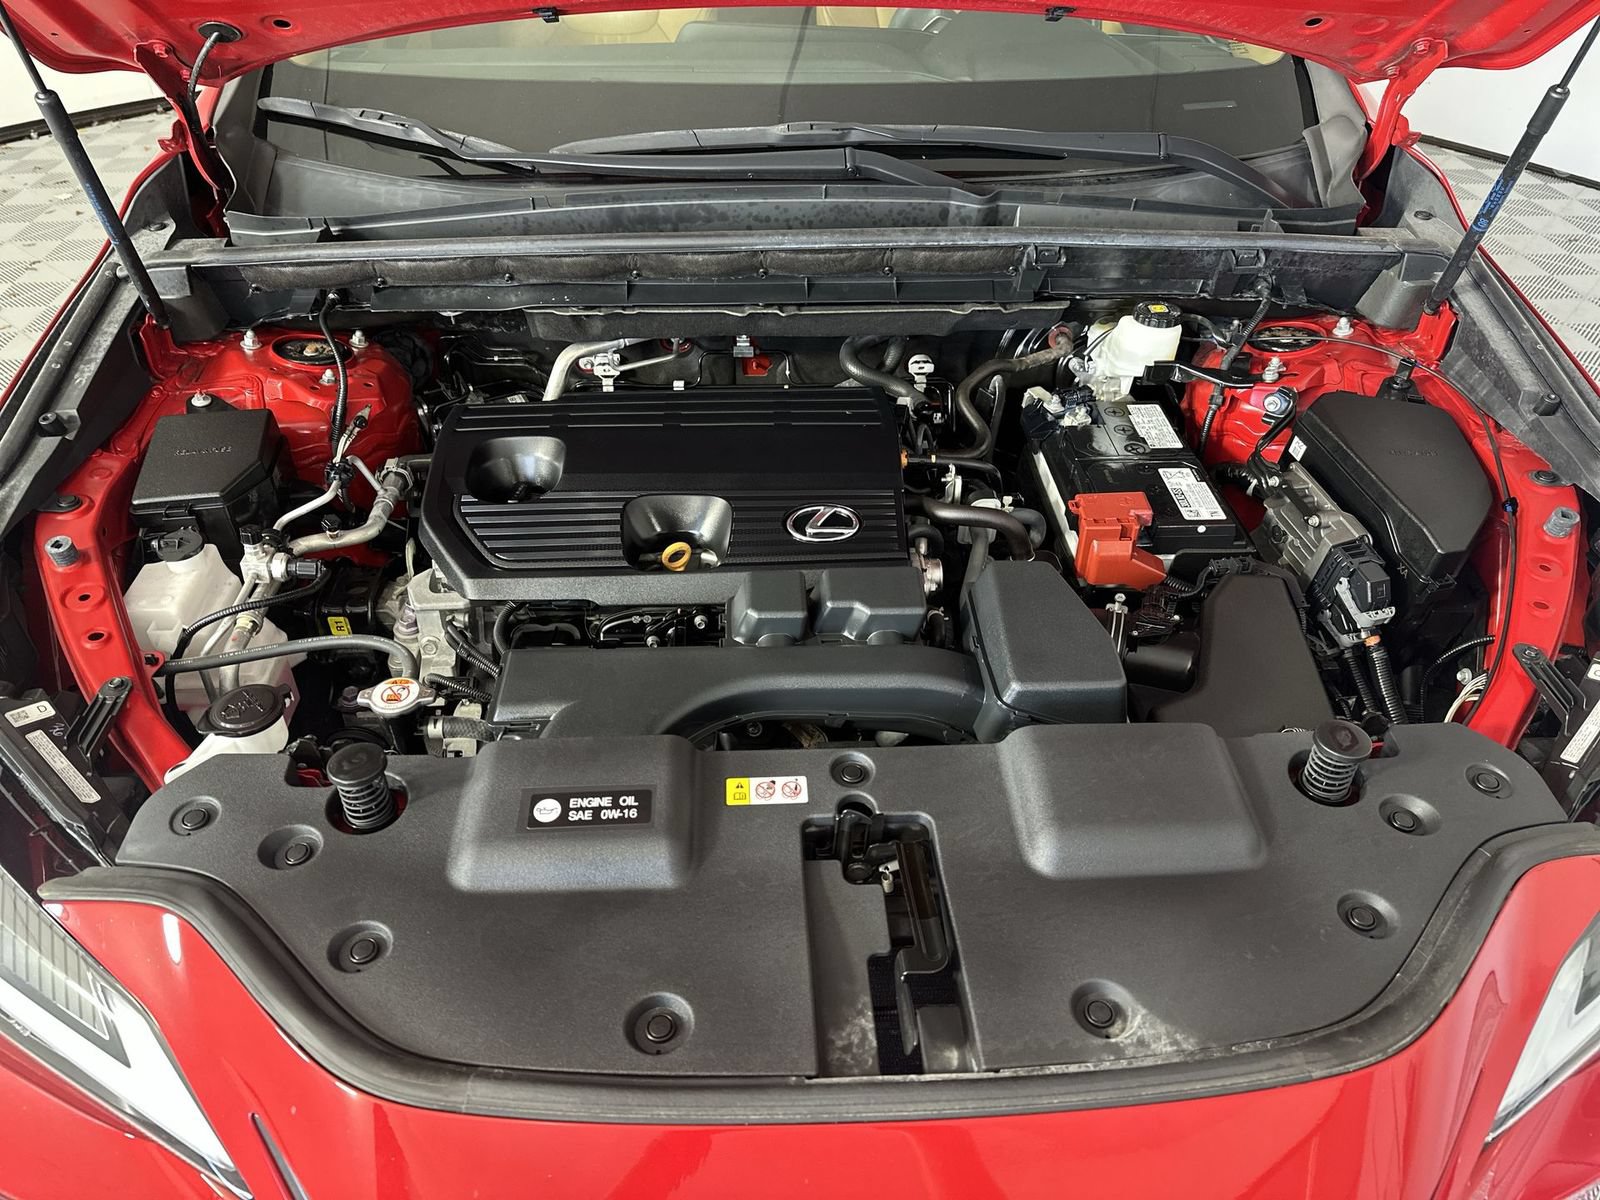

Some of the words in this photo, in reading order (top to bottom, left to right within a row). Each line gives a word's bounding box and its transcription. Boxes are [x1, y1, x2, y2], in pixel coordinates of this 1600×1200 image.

[569, 797, 613, 808] ENGINE
[619, 796, 639, 806] OIL
[568, 810, 593, 821] SAE
[600, 808, 638, 819] 0W-16
